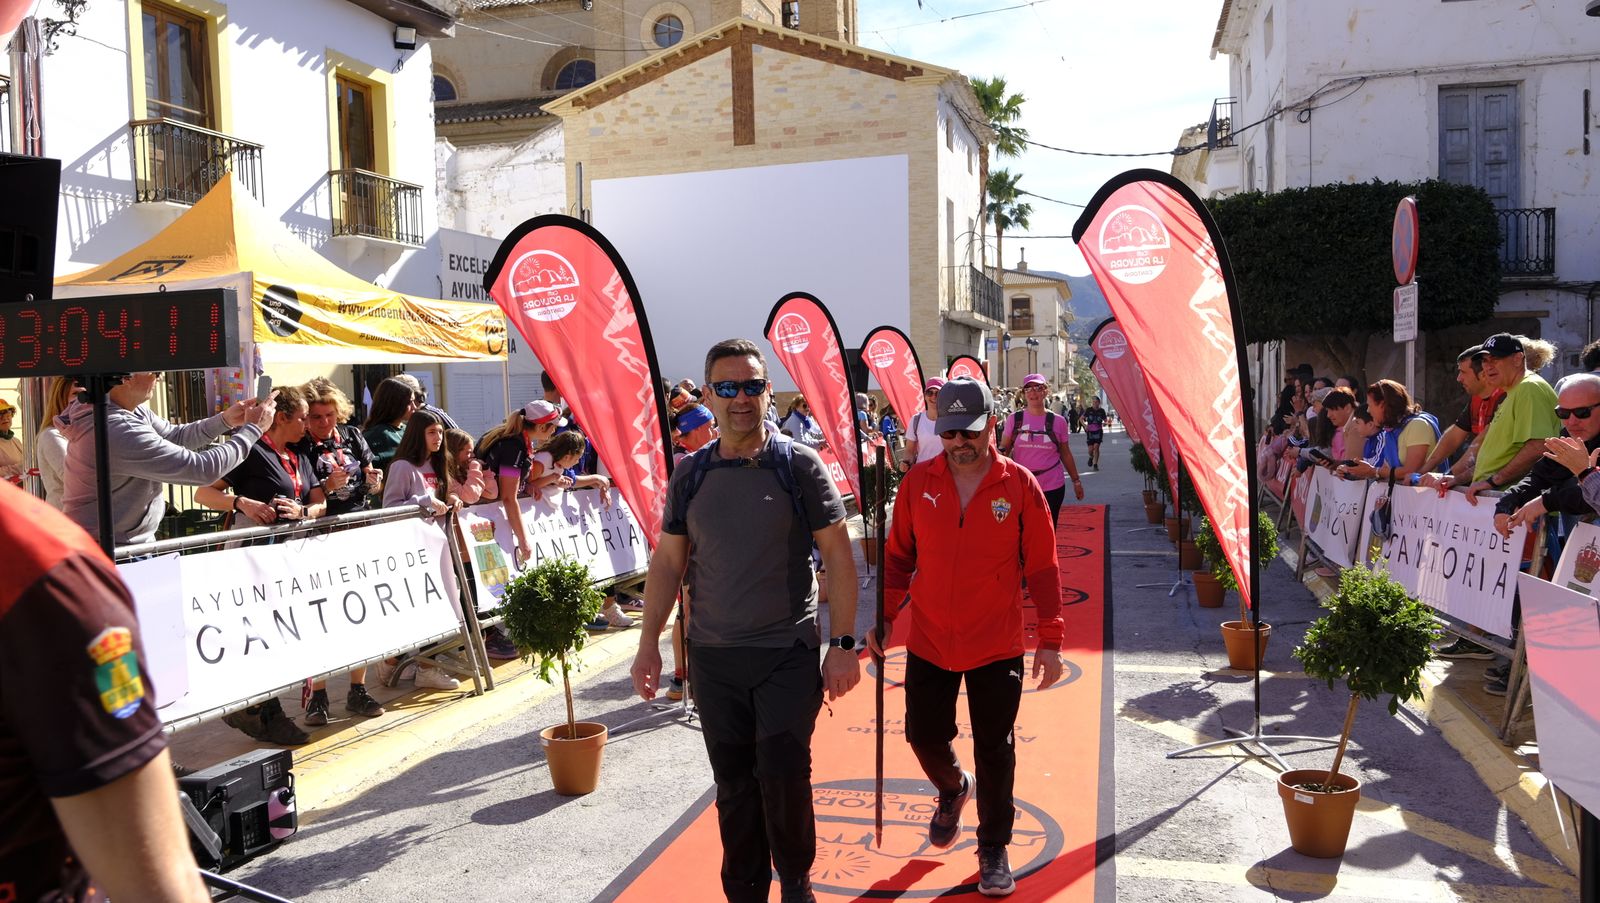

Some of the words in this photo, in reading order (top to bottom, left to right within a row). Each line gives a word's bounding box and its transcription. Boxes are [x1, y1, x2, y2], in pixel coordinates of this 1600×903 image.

[1384, 533, 1508, 599] CANTORIA
[1489, 532, 1511, 554] DE
[191, 555, 397, 614] AYUNTAMIENTO
[405, 549, 429, 568] DE
[196, 572, 442, 664] CANTORIA
